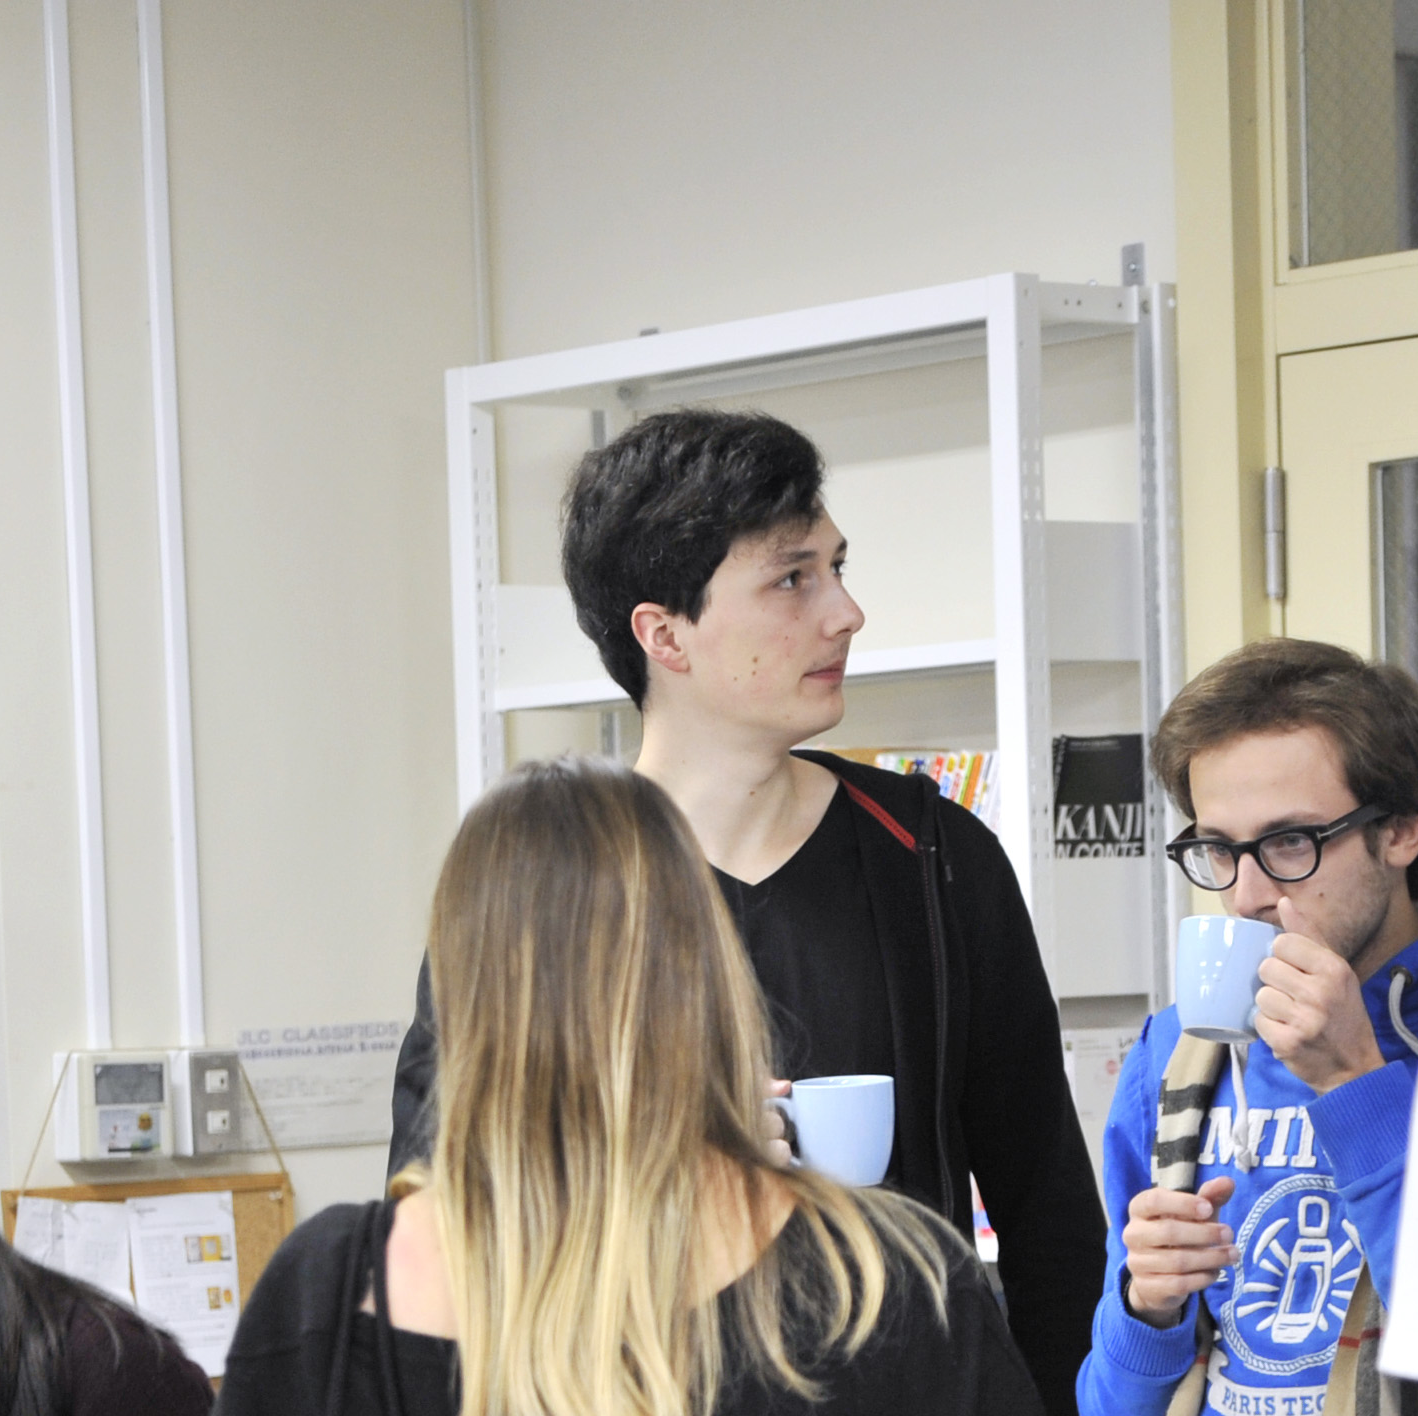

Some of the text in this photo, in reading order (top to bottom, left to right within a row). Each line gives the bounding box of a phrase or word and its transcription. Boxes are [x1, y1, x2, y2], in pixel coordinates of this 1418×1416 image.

[1056, 802, 1142, 843] KANJI
[237, 1021, 399, 1046] JLC CLASSIFIEDS
[1222, 1386, 1277, 1416] PARIS
